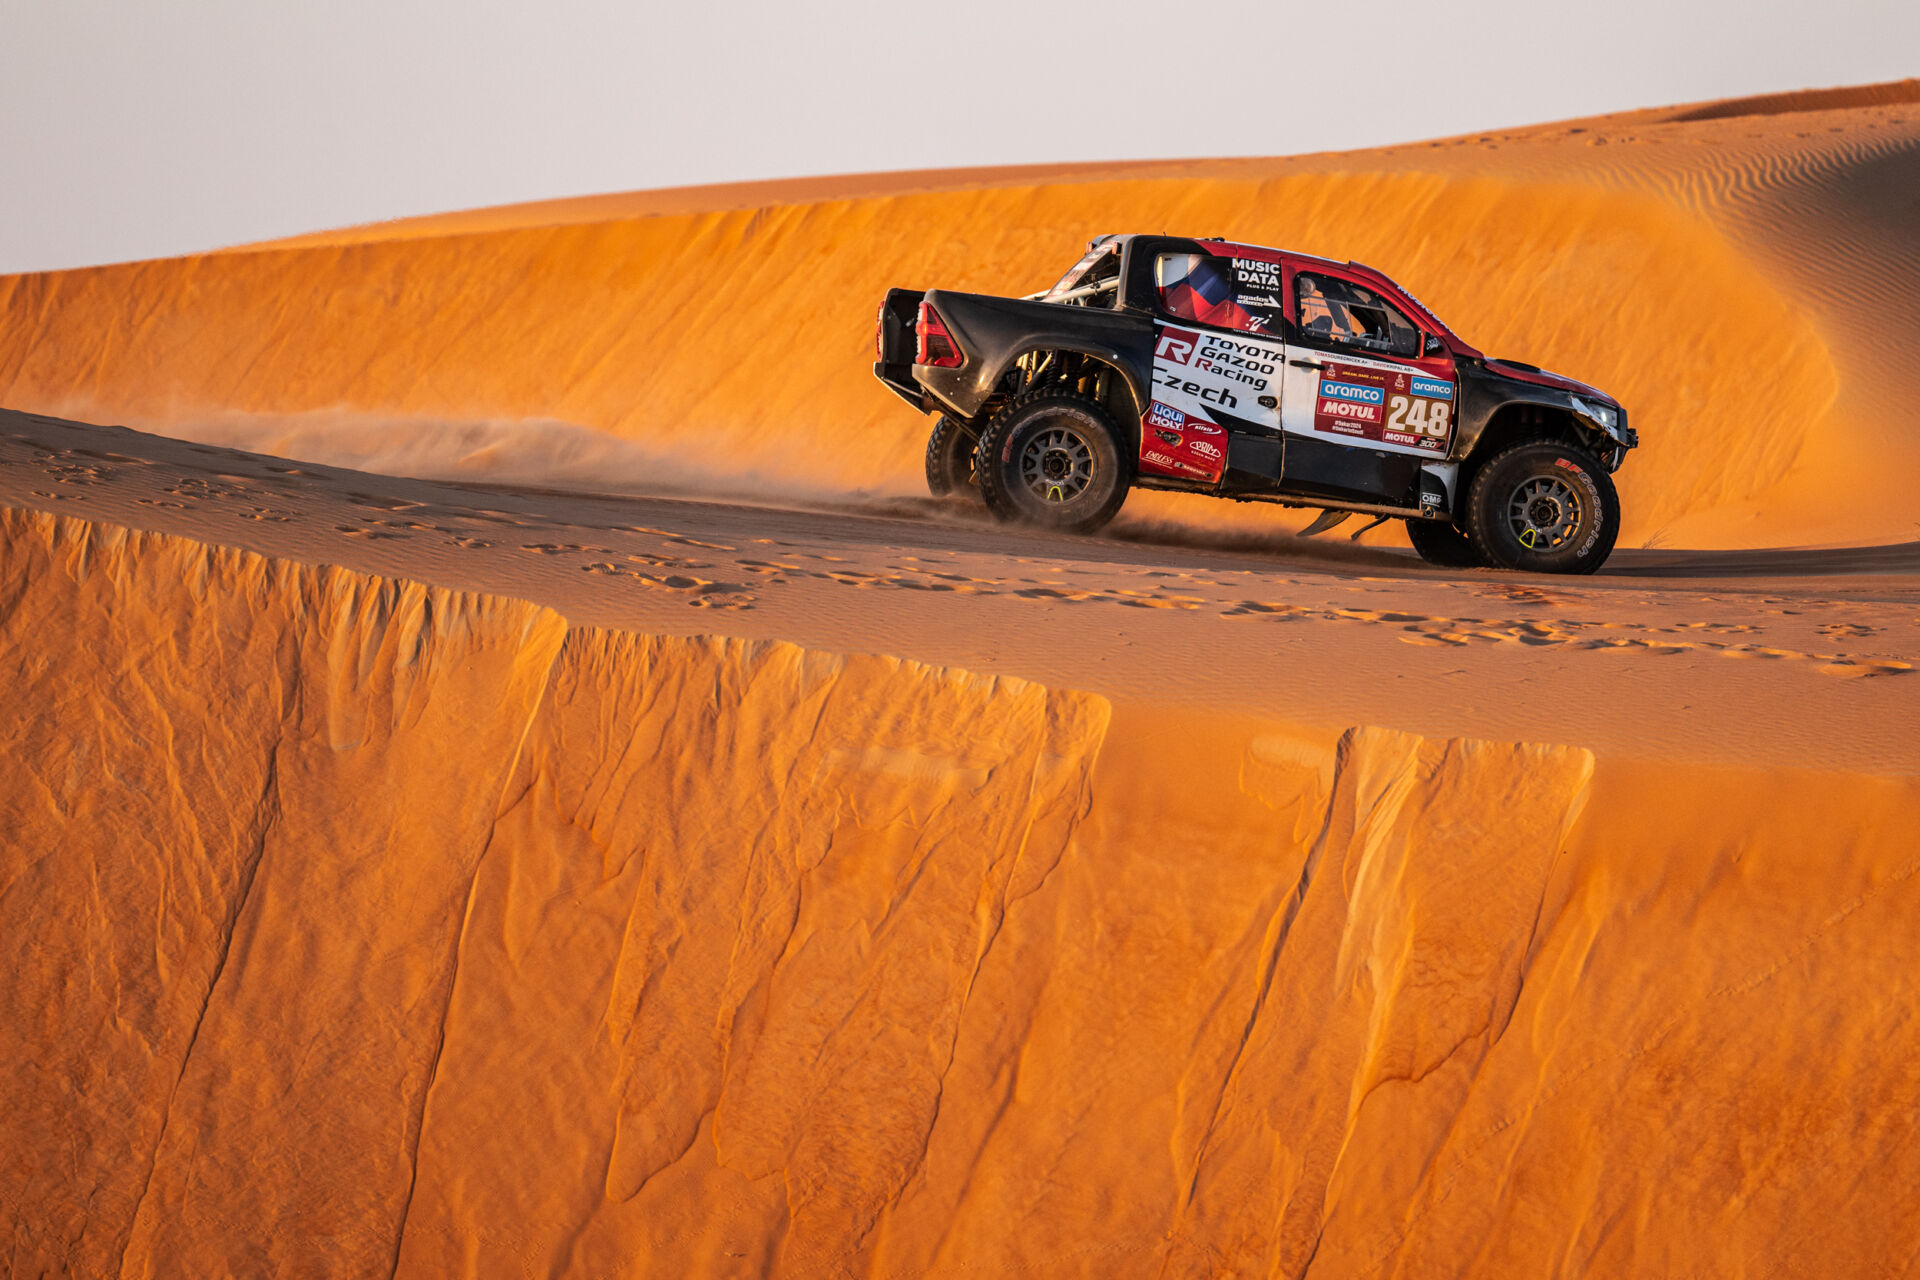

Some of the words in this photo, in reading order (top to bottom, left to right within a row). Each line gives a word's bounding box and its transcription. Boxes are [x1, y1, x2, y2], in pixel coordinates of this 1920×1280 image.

[1232, 258, 1280, 275] MUSIC
[1238, 270, 1280, 286] DATA
[1205, 335, 1286, 364] TOYOTA
[1200, 346, 1275, 375] GAZOO
[1194, 357, 1268, 391] Racing
[1324, 384, 1380, 401] aramco
[1413, 382, 1451, 394] aramco
[1154, 404, 1184, 422] LIQUI
[1323, 401, 1375, 420] MOTUL
[1387, 396, 1450, 436] 248
[1152, 414, 1182, 430] MOLY
[1384, 432, 1416, 444] MOTUL
[1145, 450, 1174, 464] ENDLESS
[1422, 494, 1442, 504] OMP
